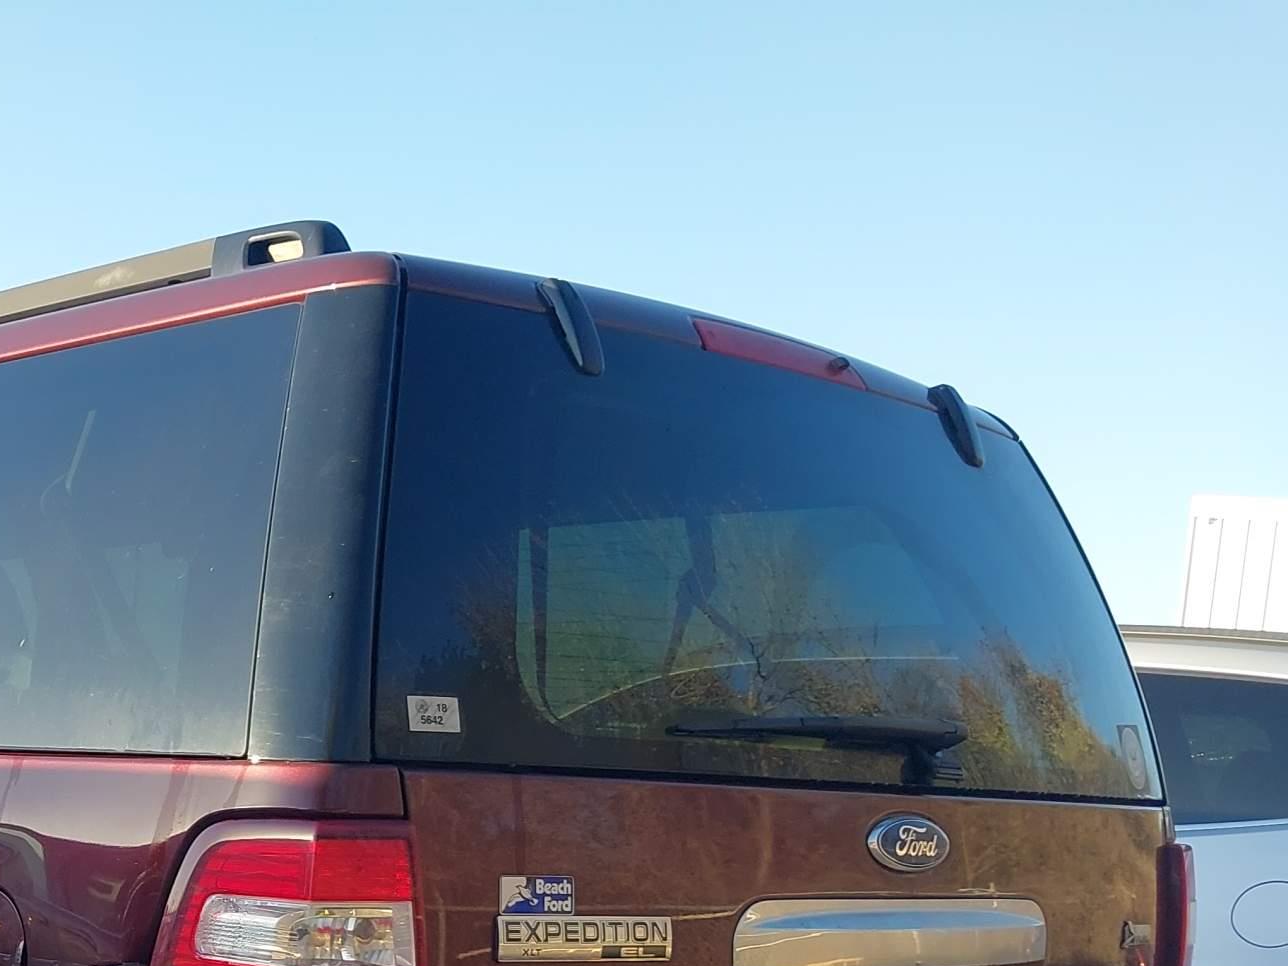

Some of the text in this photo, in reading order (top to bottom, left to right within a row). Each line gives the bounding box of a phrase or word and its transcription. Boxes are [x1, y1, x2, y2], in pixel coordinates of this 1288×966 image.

[437, 703, 448, 713] 18
[420, 715, 444, 726] 5642
[895, 825, 938, 857] Ford
[535, 879, 572, 895] Beach
[544, 896, 572, 912] Ford
[505, 921, 668, 943] EXPEDITION
[521, 947, 656, 957] XLT EL
